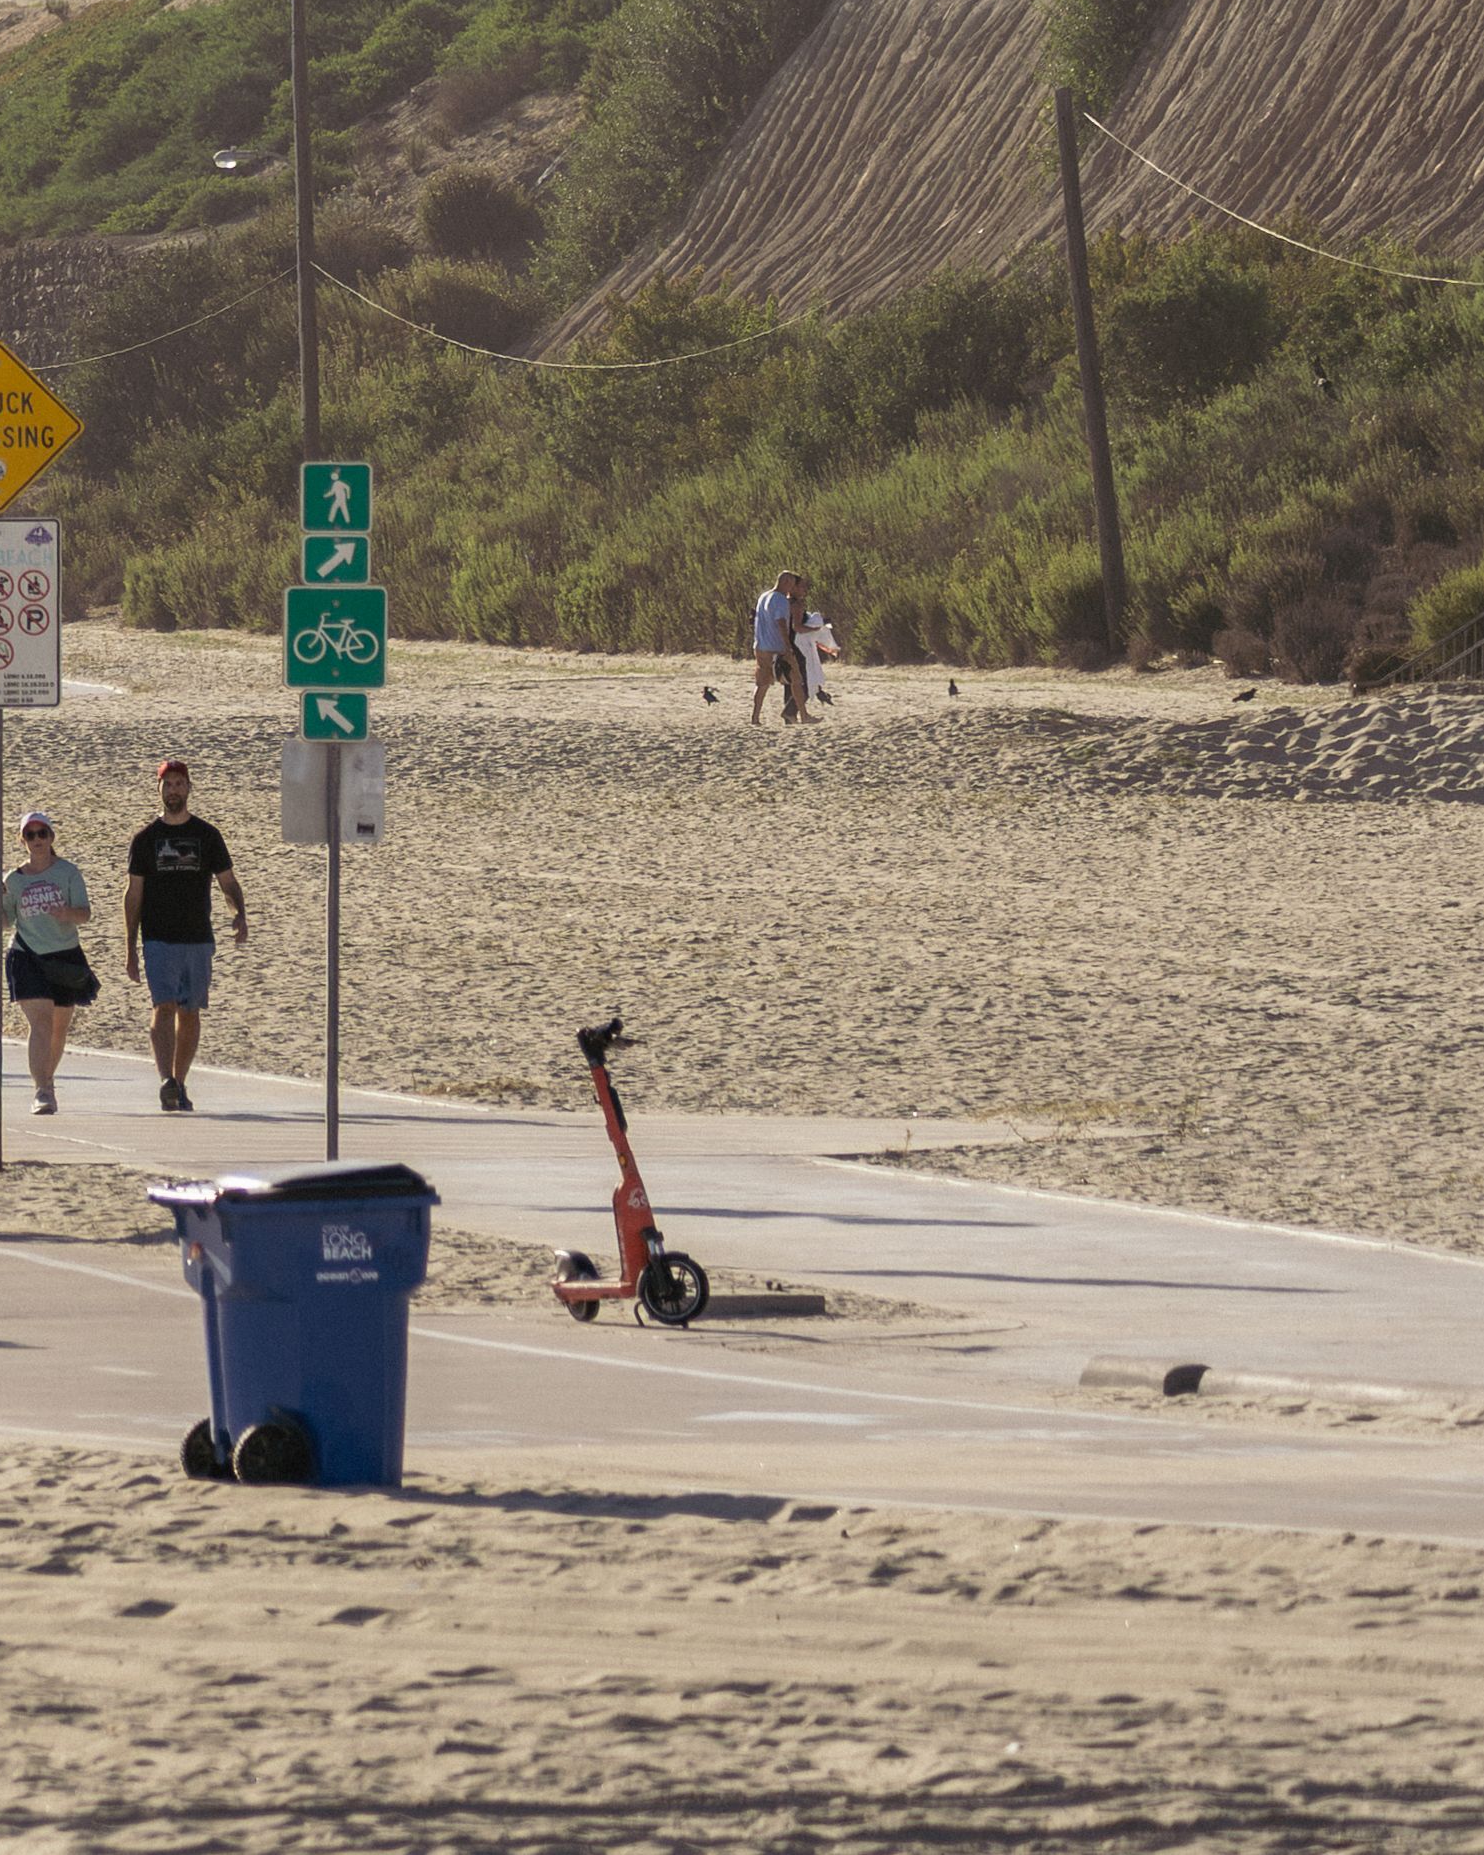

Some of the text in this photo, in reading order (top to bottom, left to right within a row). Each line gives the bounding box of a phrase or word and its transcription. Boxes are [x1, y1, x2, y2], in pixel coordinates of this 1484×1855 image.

[22, 890, 63, 906] DISNEY
[322, 1231, 367, 1246] LONG
[323, 1245, 372, 1260] BEACH
